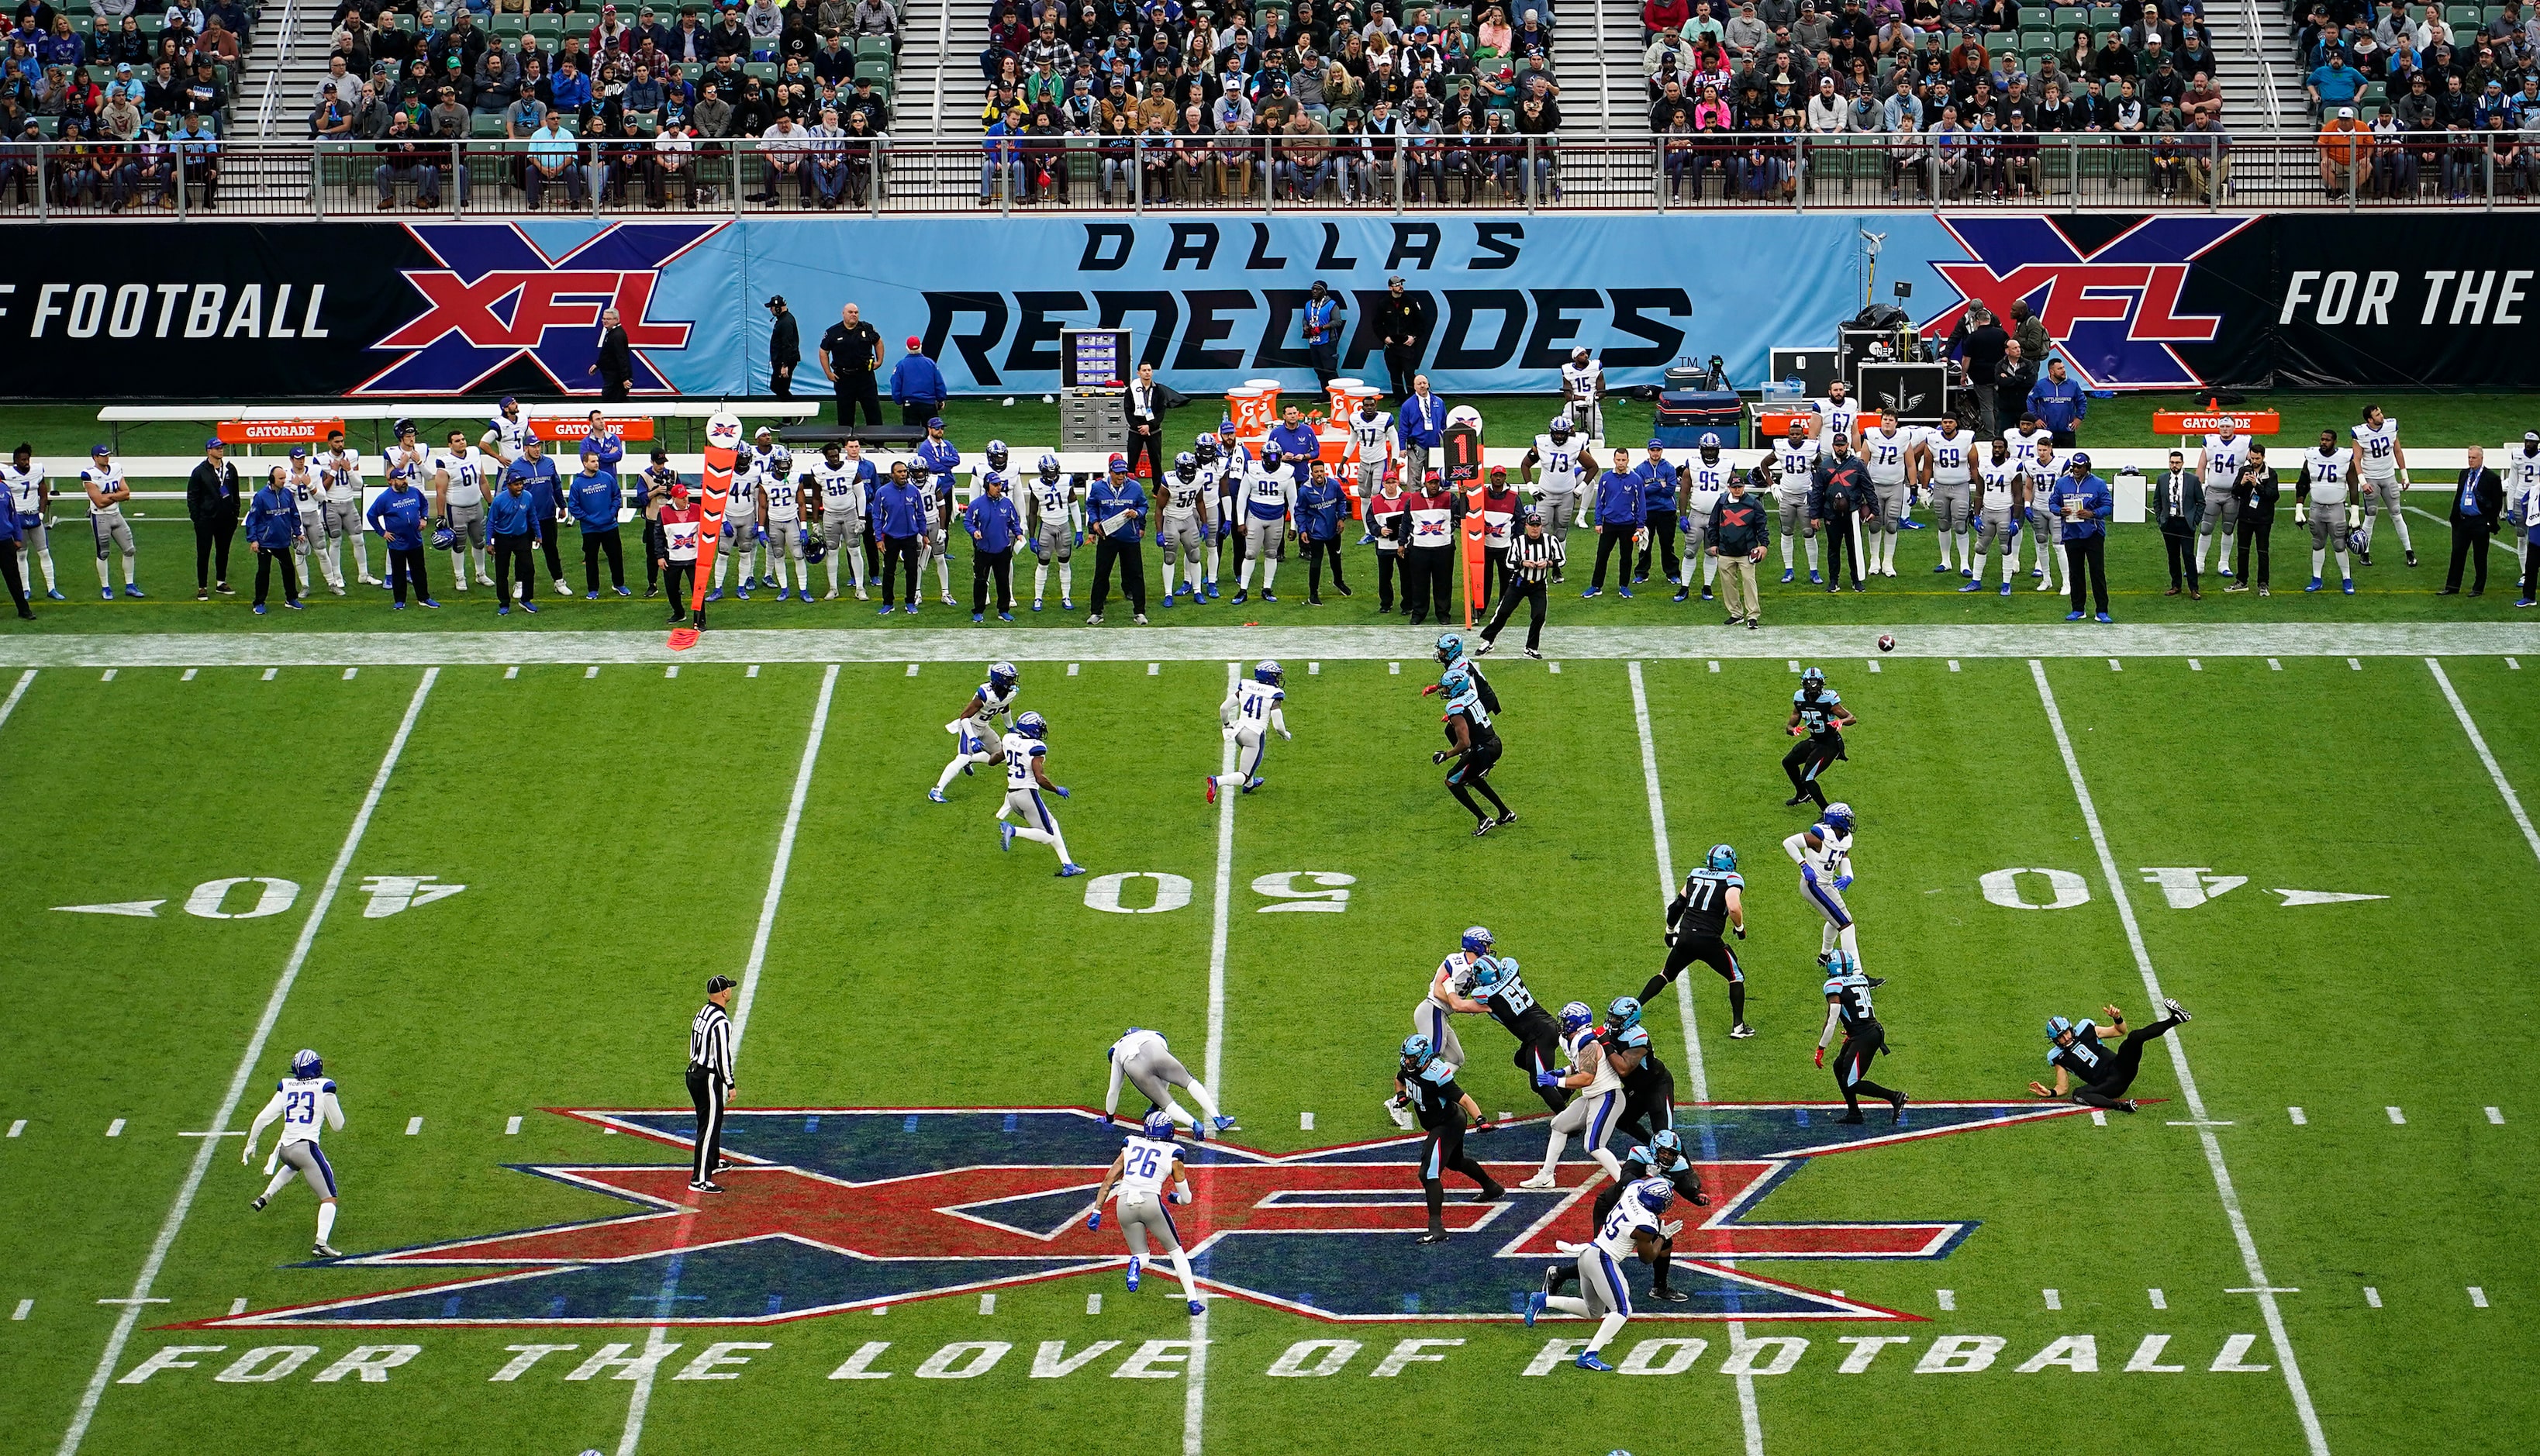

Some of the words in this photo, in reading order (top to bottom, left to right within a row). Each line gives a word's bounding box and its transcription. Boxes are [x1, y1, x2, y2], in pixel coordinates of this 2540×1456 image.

[1077, 221, 1524, 271] DALLAS
[2279, 271, 2400, 325] FOR
[2421, 271, 2534, 325] THE
[31, 284, 330, 338] FOOTBALL
[921, 288, 1693, 386] RENEGADES
[1679, 357, 1699, 367] TM
[1575, 377, 1591, 392] 15
[1241, 402, 1254, 416] G
[1332, 395, 1344, 410] G
[246, 426, 315, 436] GATORADE
[555, 424, 624, 435] GATODE
[1832, 413, 1850, 433] 67
[2183, 418, 2252, 429] GATODE
[513, 430, 521, 449] 5
[1360, 428, 1376, 447] 17
[2370, 436, 2390, 458] 82
[1454, 434, 1468, 464] 1
[1877, 446, 1897, 465] 72
[1939, 448, 1959, 468] 69
[2016, 444, 2034, 459] 75
[407, 463, 416, 479] 4
[1550, 452, 1569, 473] 73
[1786, 455, 1806, 474] 83
[2215, 454, 2235, 474] 64
[336, 468, 349, 486] 10
[460, 464, 478, 487] 61
[1204, 473, 1213, 492] 2
[1699, 471, 1719, 492] 95
[1986, 474, 2004, 492] 24
[2036, 474, 2055, 492] 87
[2317, 464, 2337, 483] 76
[21, 481, 30, 499] 7
[298, 485, 308, 501] 6
[729, 482, 751, 503] 44
[771, 488, 792, 506] 22
[827, 478, 847, 496] 56
[1258, 480, 1279, 496] 96
[1044, 492, 1063, 512] 21
[1176, 490, 1196, 508] 58
[1243, 694, 1264, 719] 41
[1801, 710, 1825, 733] 25
[1007, 750, 1026, 778] 25
[1688, 878, 1717, 911] 77
[1489, 969, 1514, 992] BALDUCCI
[1499, 975, 1534, 1016] 65
[1850, 986, 1876, 1018] 34
[2073, 1044, 2098, 1068] 9
[1404, 1078, 1427, 1112] 64
[285, 1092, 315, 1123] 23
[1126, 1146, 1161, 1178] 26
[1627, 1194, 1641, 1216] ANKRAH
[1604, 1202, 1630, 1240] 55
[117, 1344, 423, 1384] FOR
[488, 1342, 773, 1382] THE
[828, 1339, 1213, 1379] LOVE
[1266, 1338, 1467, 1378] OF
[1521, 1334, 2273, 1376] FOOTBALL
